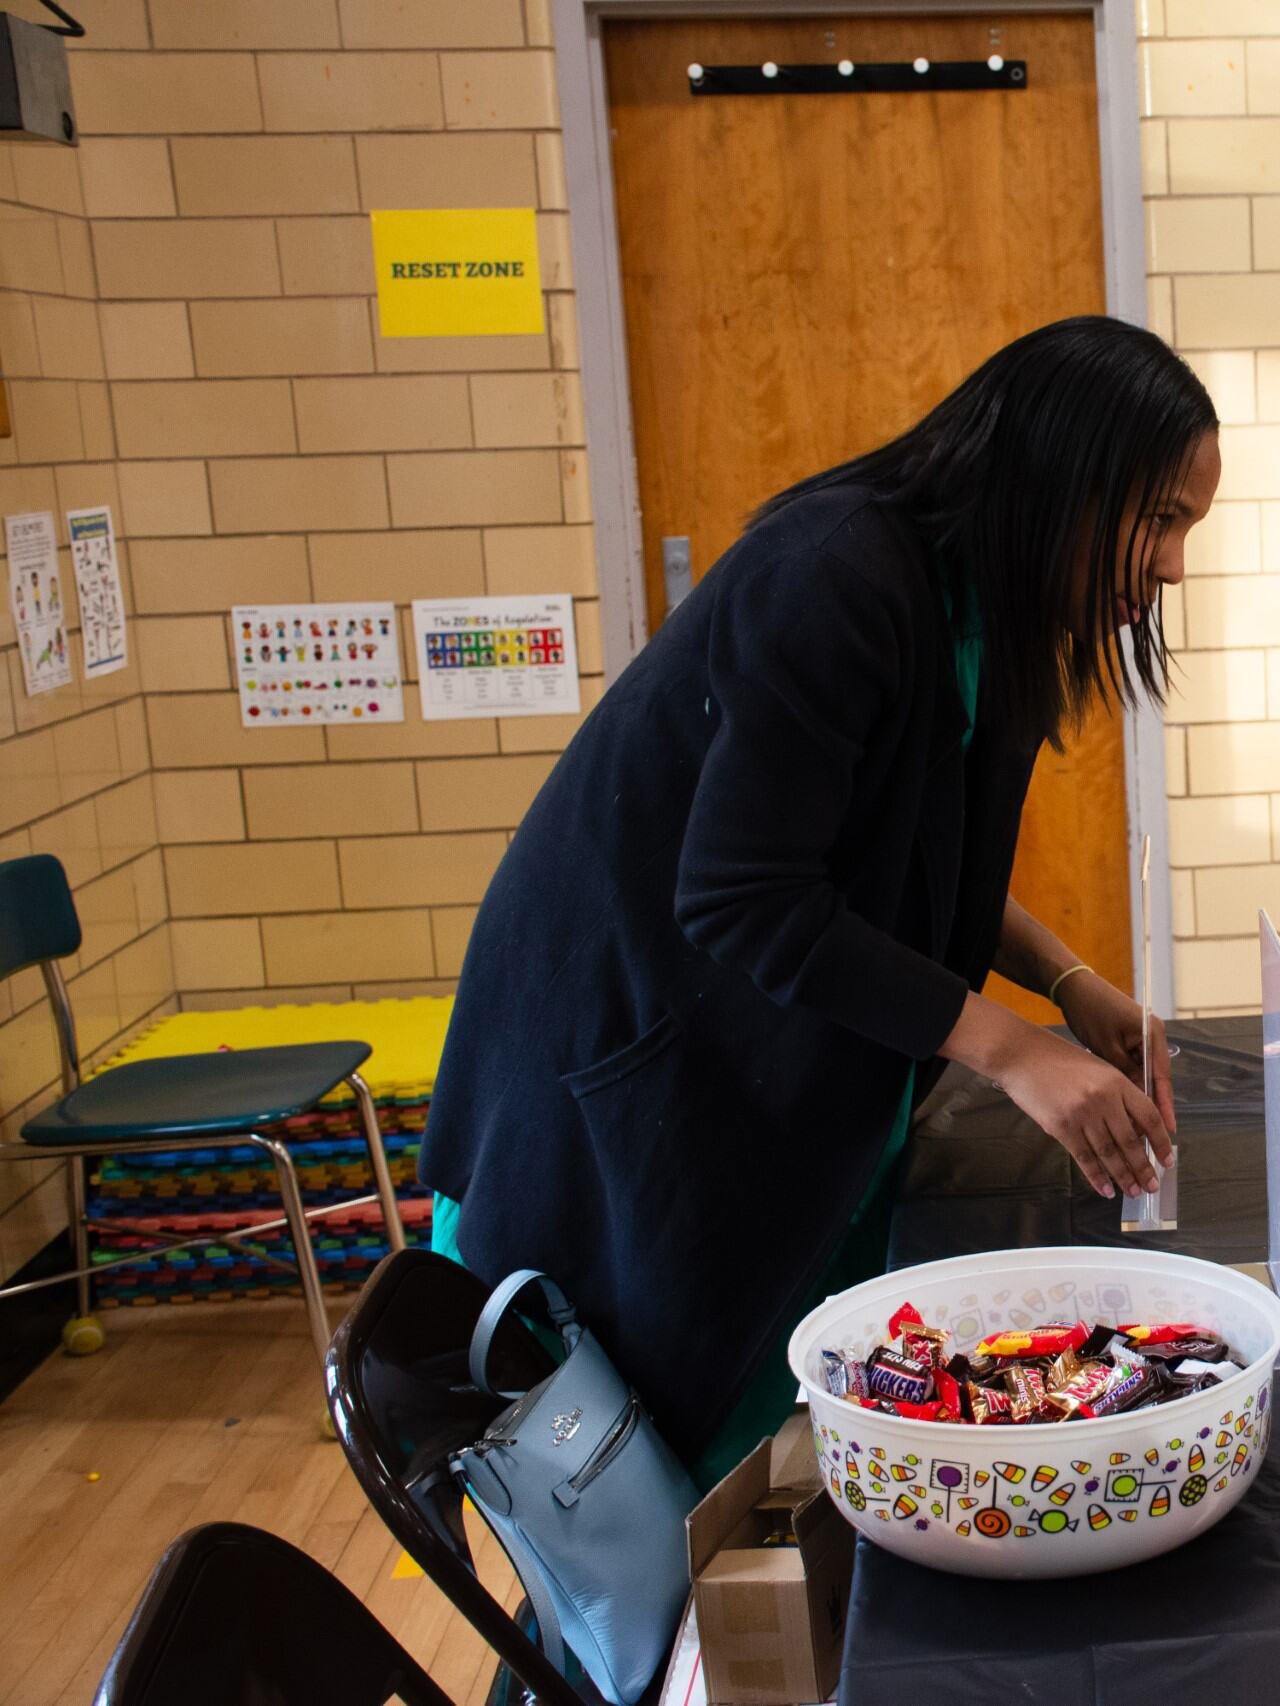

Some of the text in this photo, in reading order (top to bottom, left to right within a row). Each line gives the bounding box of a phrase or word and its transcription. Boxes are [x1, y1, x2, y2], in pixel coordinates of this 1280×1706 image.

[391, 261, 524, 279] RESET ZONE
[453, 614, 490, 627] ZONES
[1016, 1378, 1029, 1403] minis
